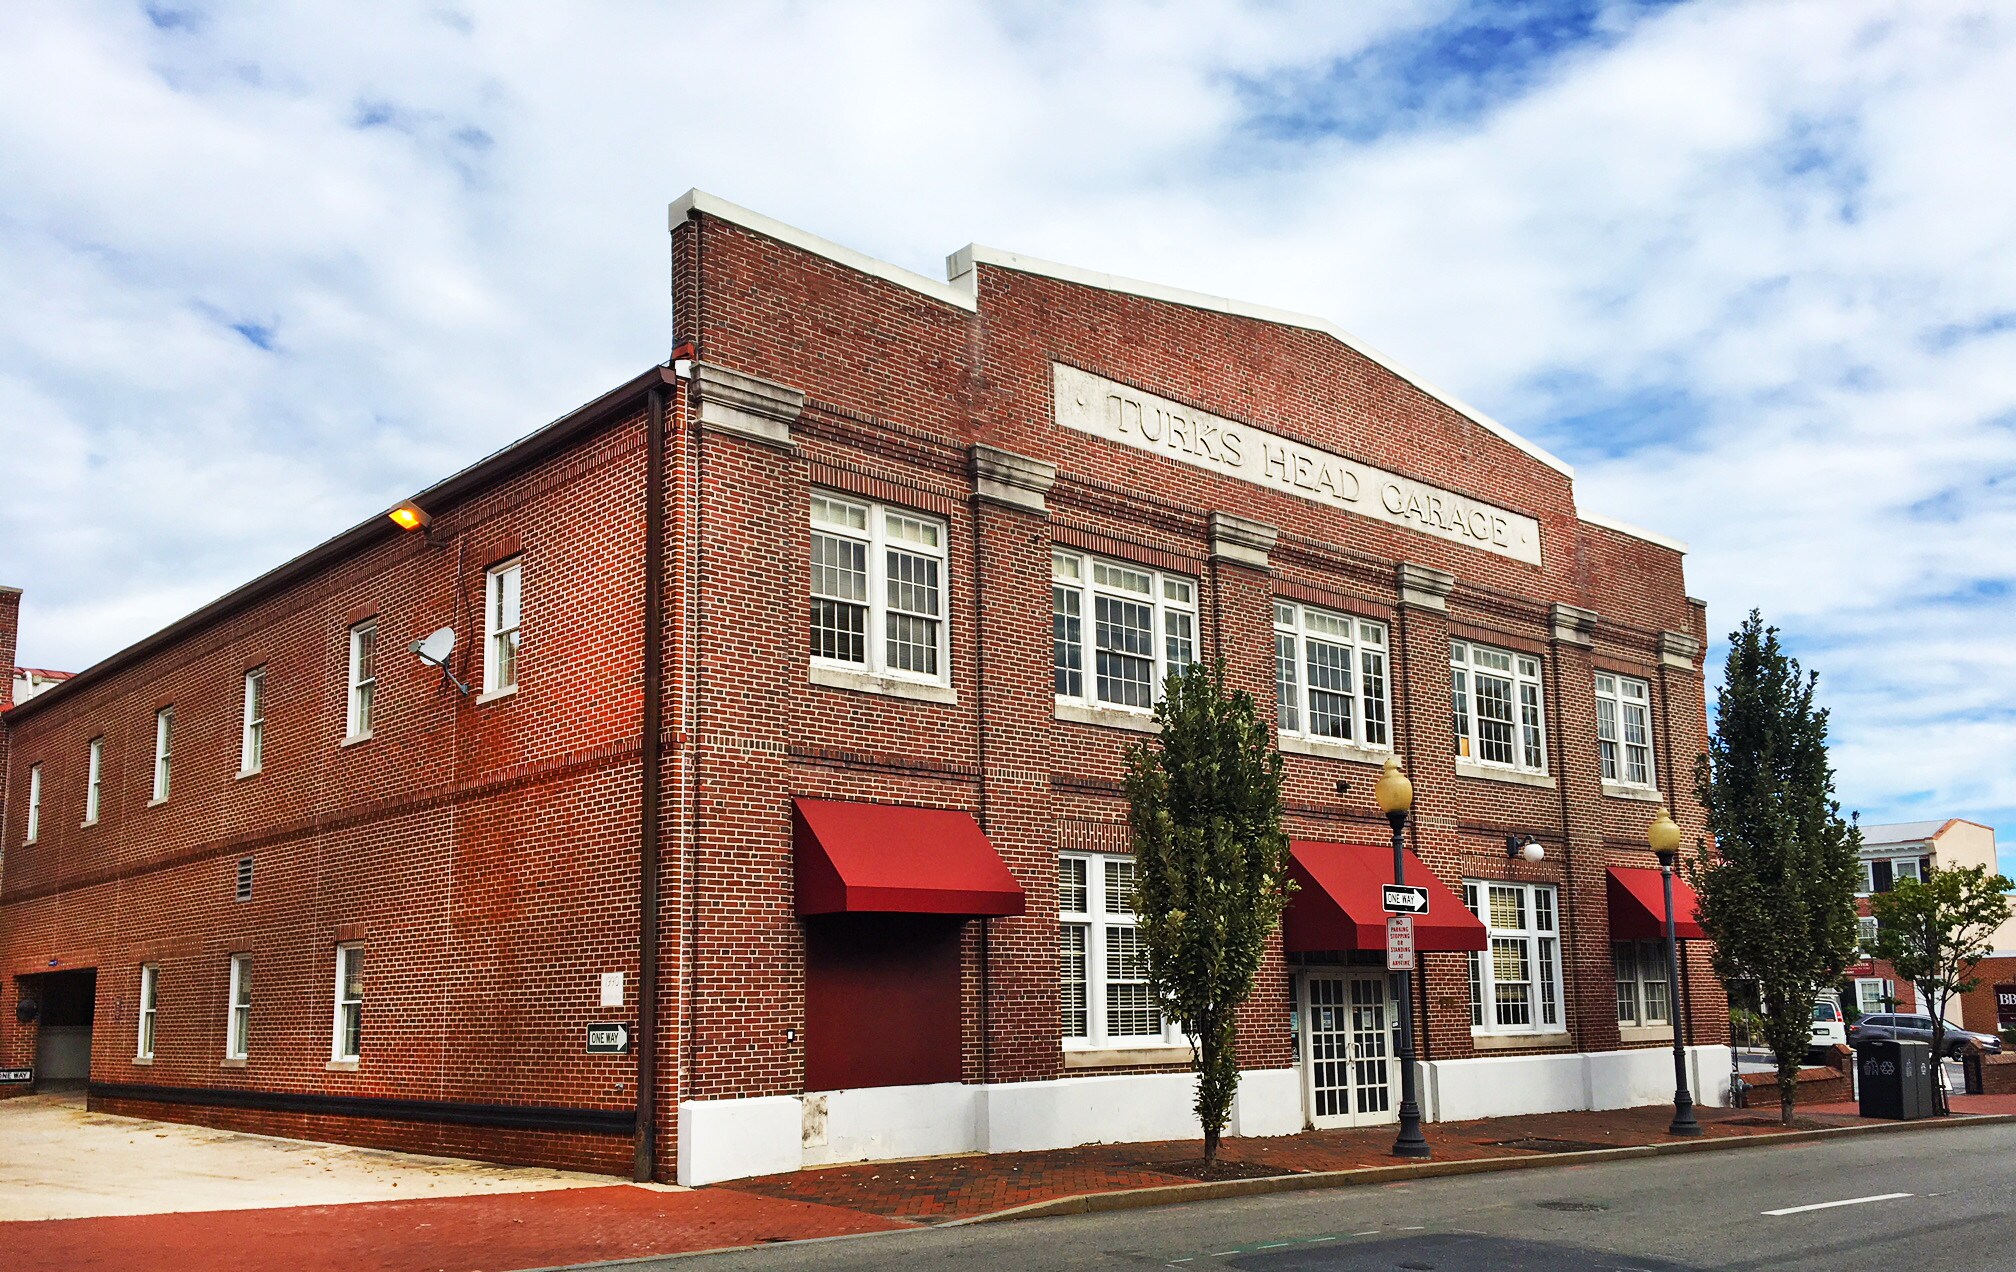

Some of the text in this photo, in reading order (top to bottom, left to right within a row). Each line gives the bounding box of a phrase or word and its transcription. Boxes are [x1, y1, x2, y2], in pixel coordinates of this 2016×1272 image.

[1107, 394, 1510, 549] TURKS HEAD GARAGE
[1388, 893, 1415, 905] ONE WAY
[591, 1033, 619, 1044] ONE WAY
